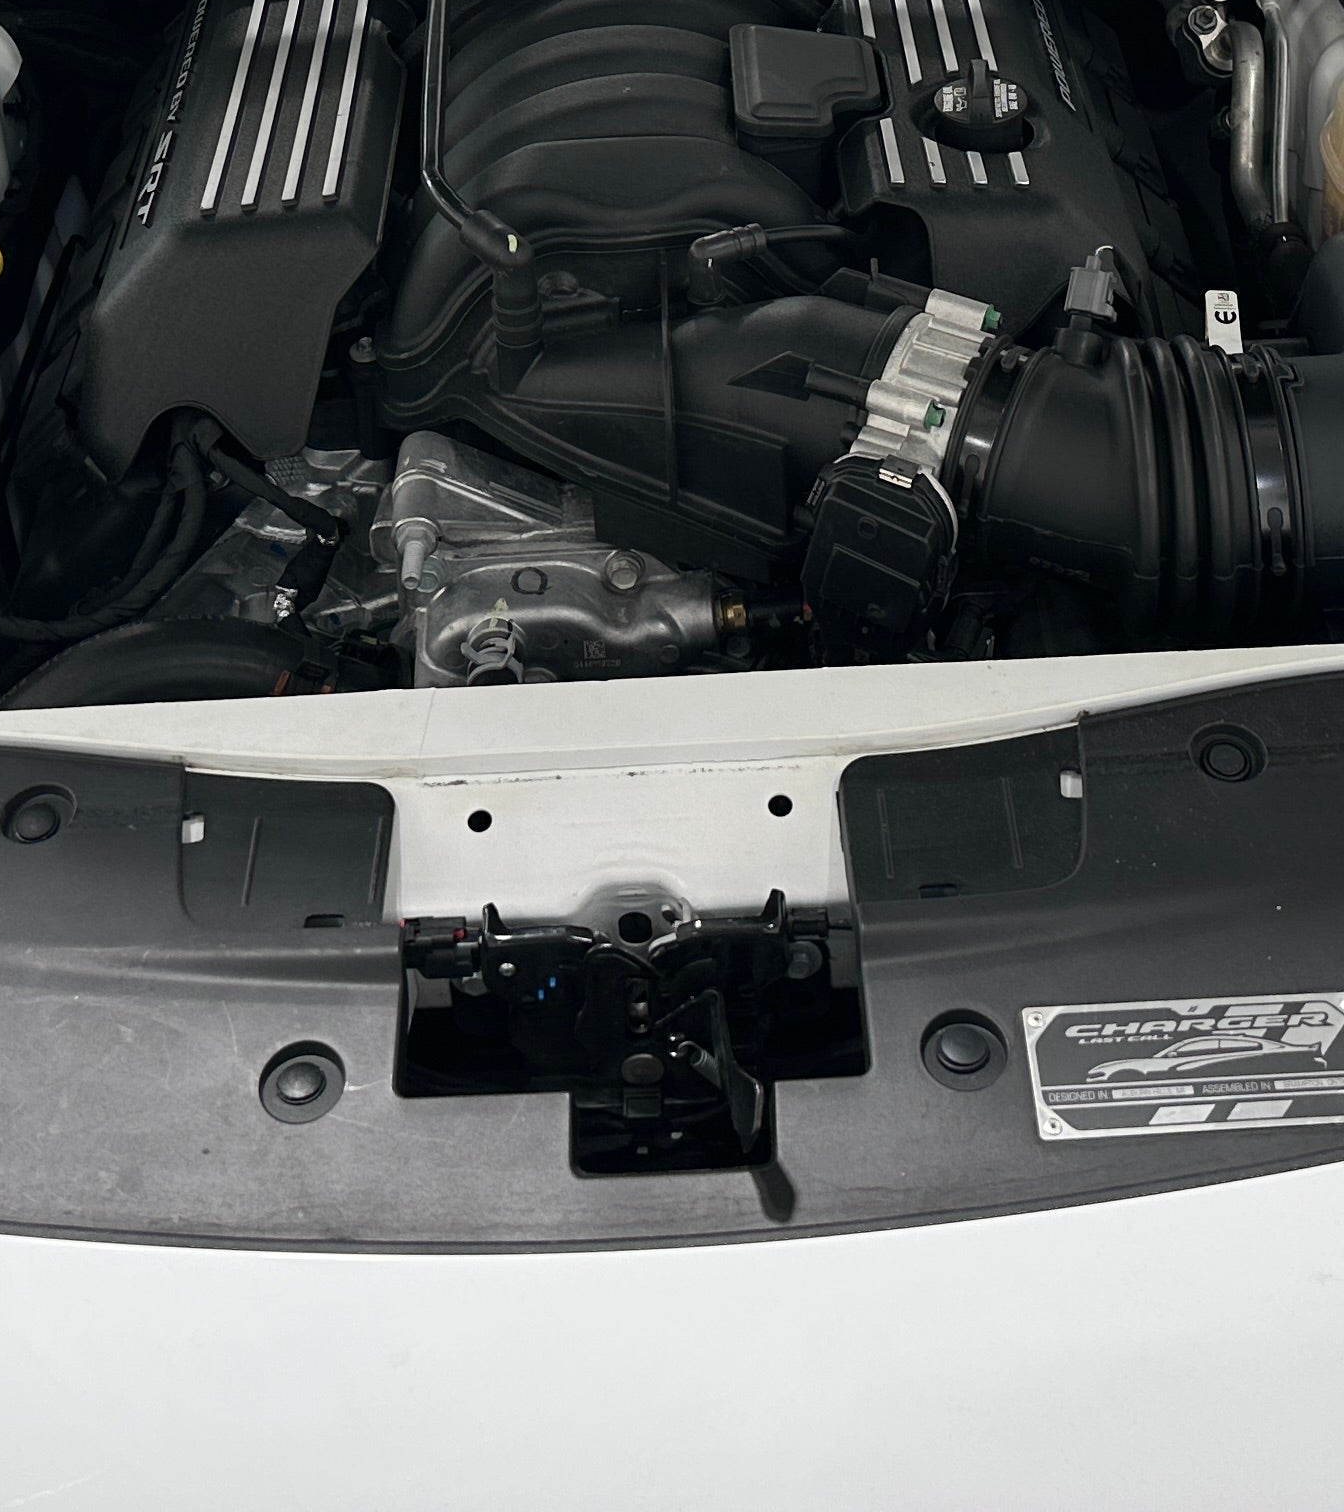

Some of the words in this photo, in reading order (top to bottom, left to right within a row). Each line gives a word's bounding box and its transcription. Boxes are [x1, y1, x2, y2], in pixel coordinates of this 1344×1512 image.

[167, 89, 183, 122] BY
[137, 130, 173, 225] SRT
[1065, 1012, 1335, 1037] CHARGER
[1078, 1036, 1125, 1045] LAST
[1127, 1033, 1174, 1042] CALL
[1048, 1090, 1095, 1103] DESIGNED
[1201, 1082, 1259, 1094] ASSEMBLED
